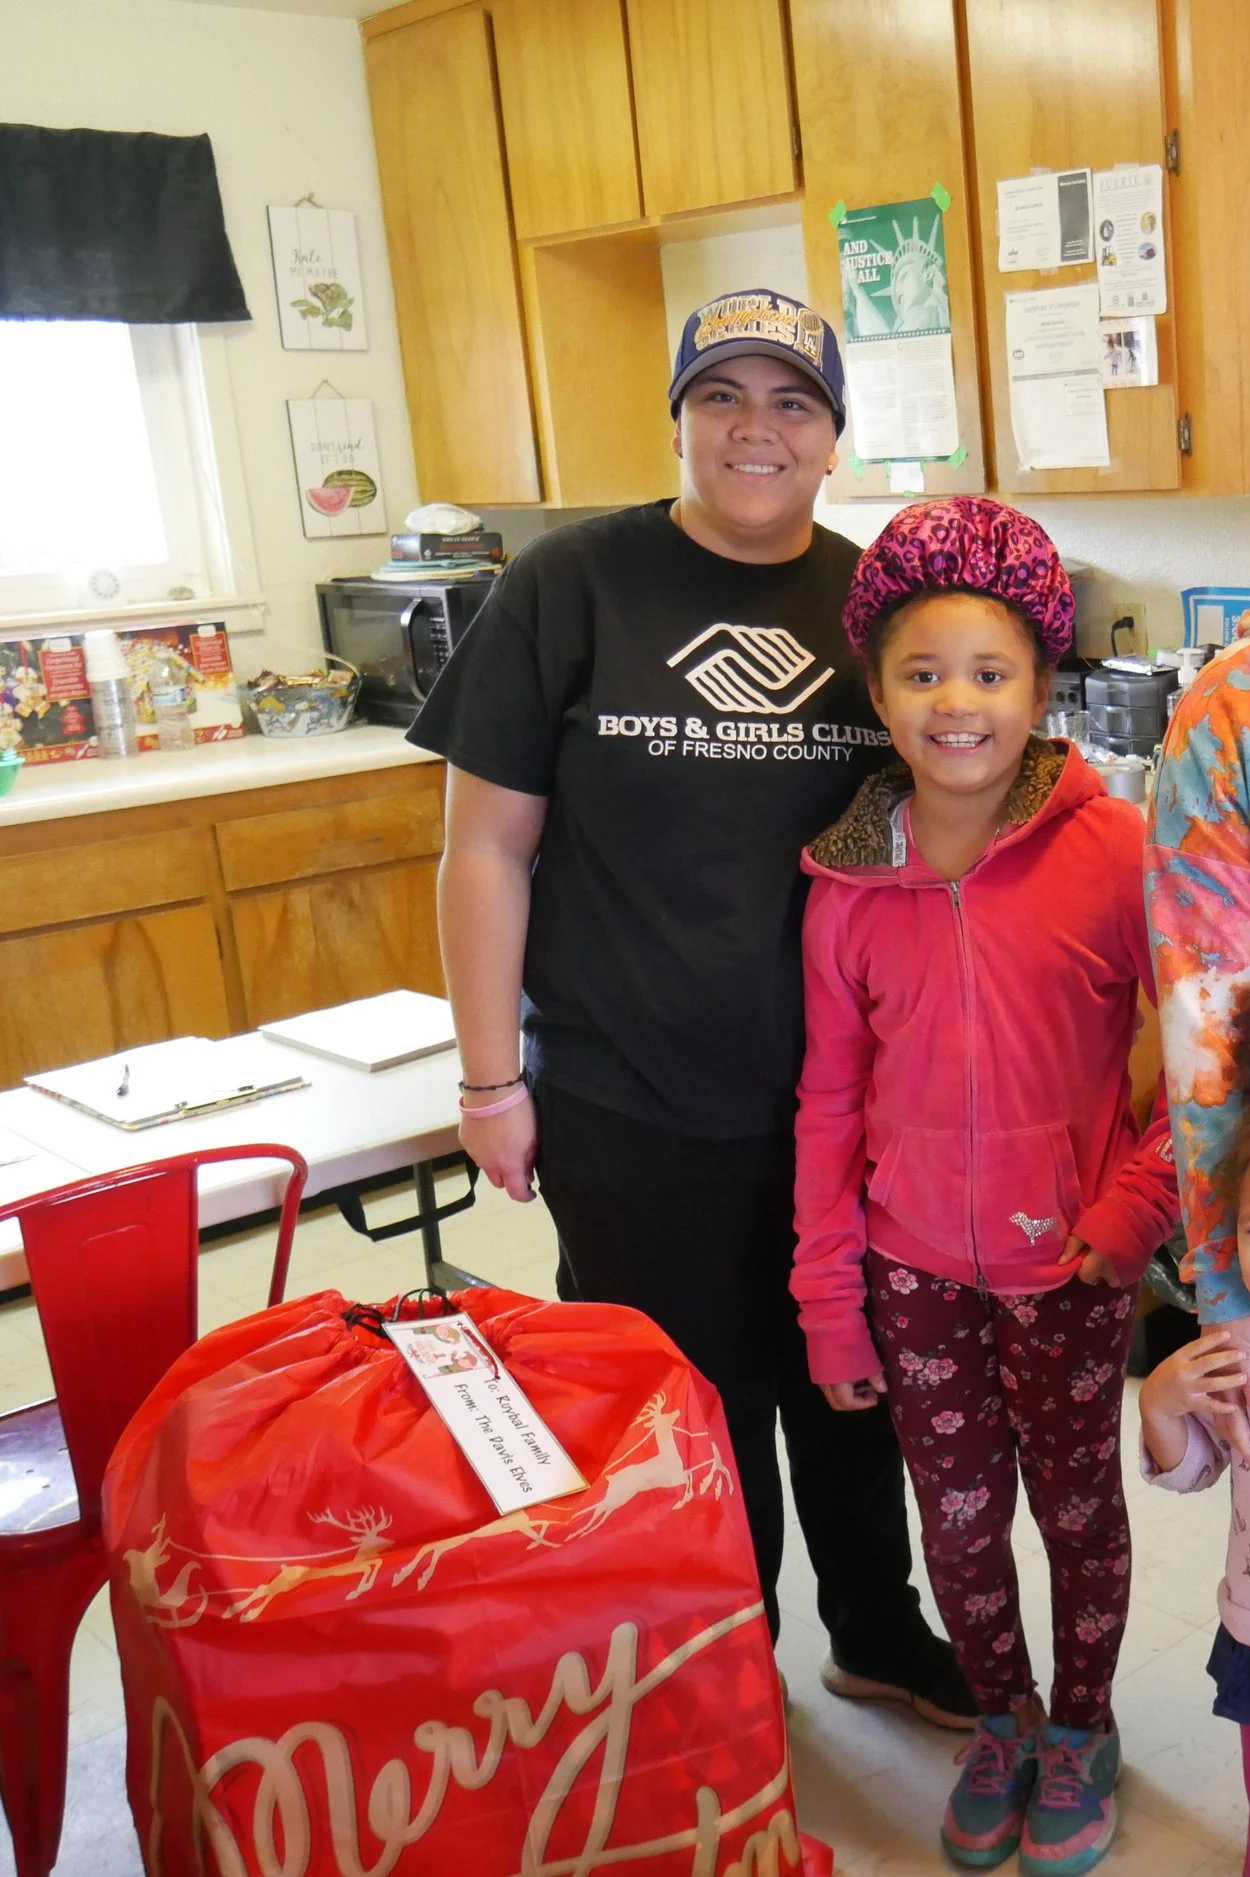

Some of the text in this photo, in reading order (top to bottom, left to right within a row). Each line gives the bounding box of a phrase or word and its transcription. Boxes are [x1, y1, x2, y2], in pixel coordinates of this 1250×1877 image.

[843, 240, 868, 255] AND
[846, 251, 893, 270] JUSTICE
[858, 268, 880, 284] ALL
[695, 318, 796, 351] SERIES
[597, 715, 892, 747] BOYS & GIRLS CLUBS
[648, 740, 853, 762] OF FRESNO COUNTY
[483, 1376, 501, 1394] To:
[520, 1431, 552, 1466] Family
[454, 1382, 534, 1494] From: The Davis Elves
[150, 1600, 766, 1877] Merry
